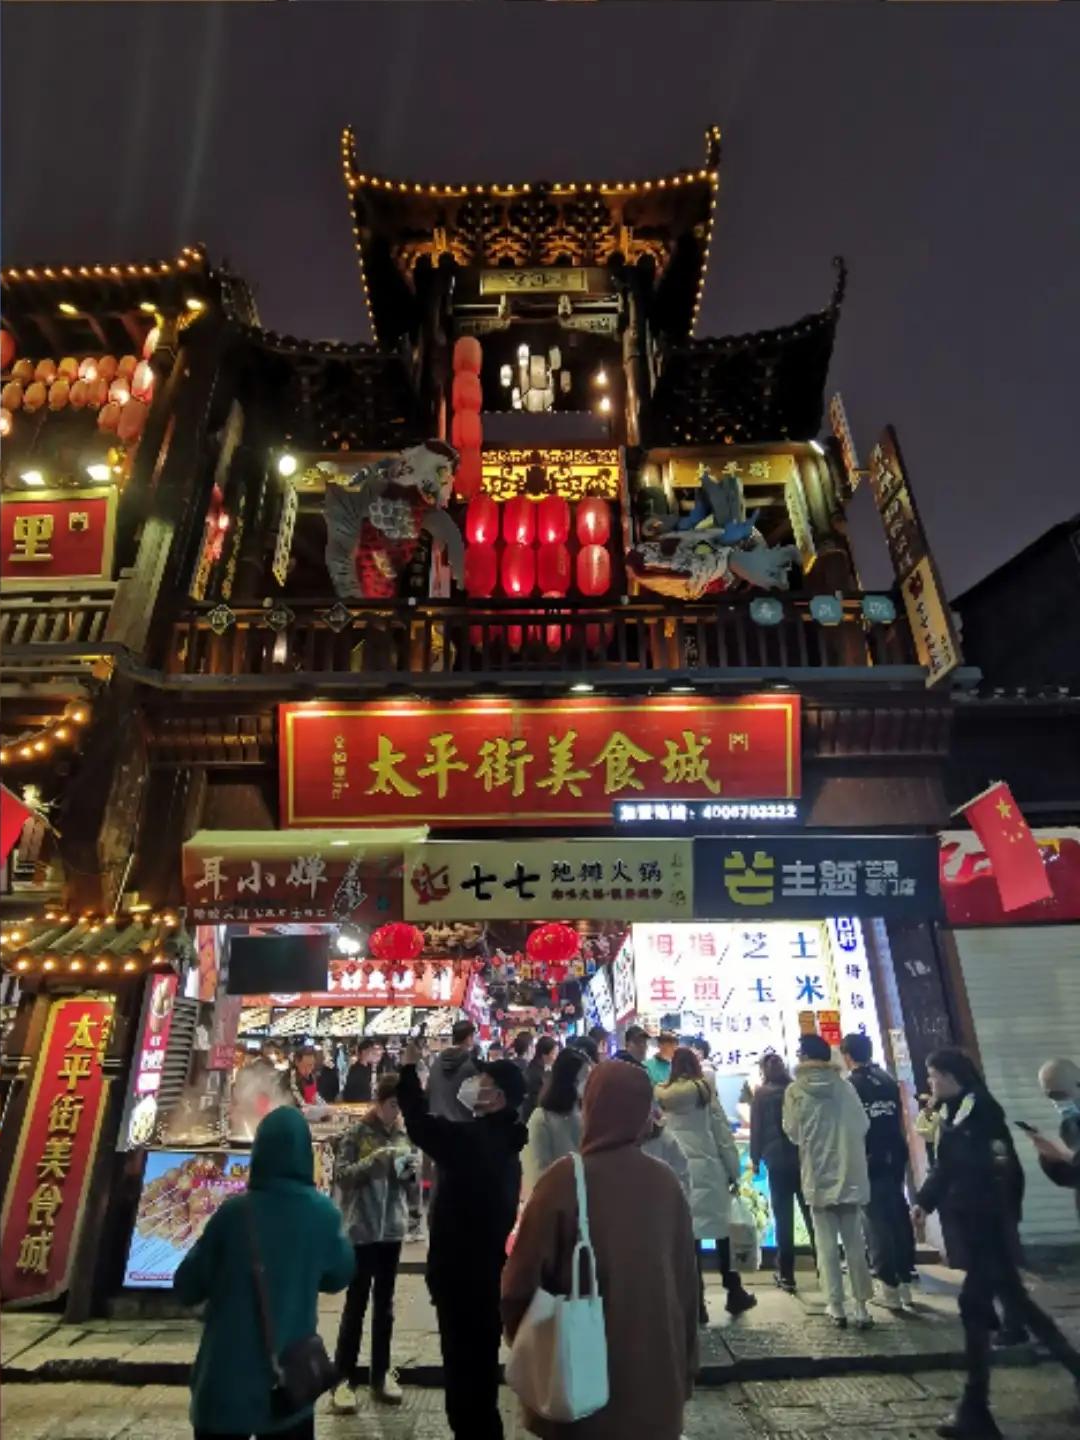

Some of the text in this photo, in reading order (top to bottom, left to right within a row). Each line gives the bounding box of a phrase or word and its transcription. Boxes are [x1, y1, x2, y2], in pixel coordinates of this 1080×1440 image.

[364, 730, 721, 798] 太平街美食城
[460, 862, 541, 901] 七七
[16, 1012, 99, 1275] 太平街美食城
